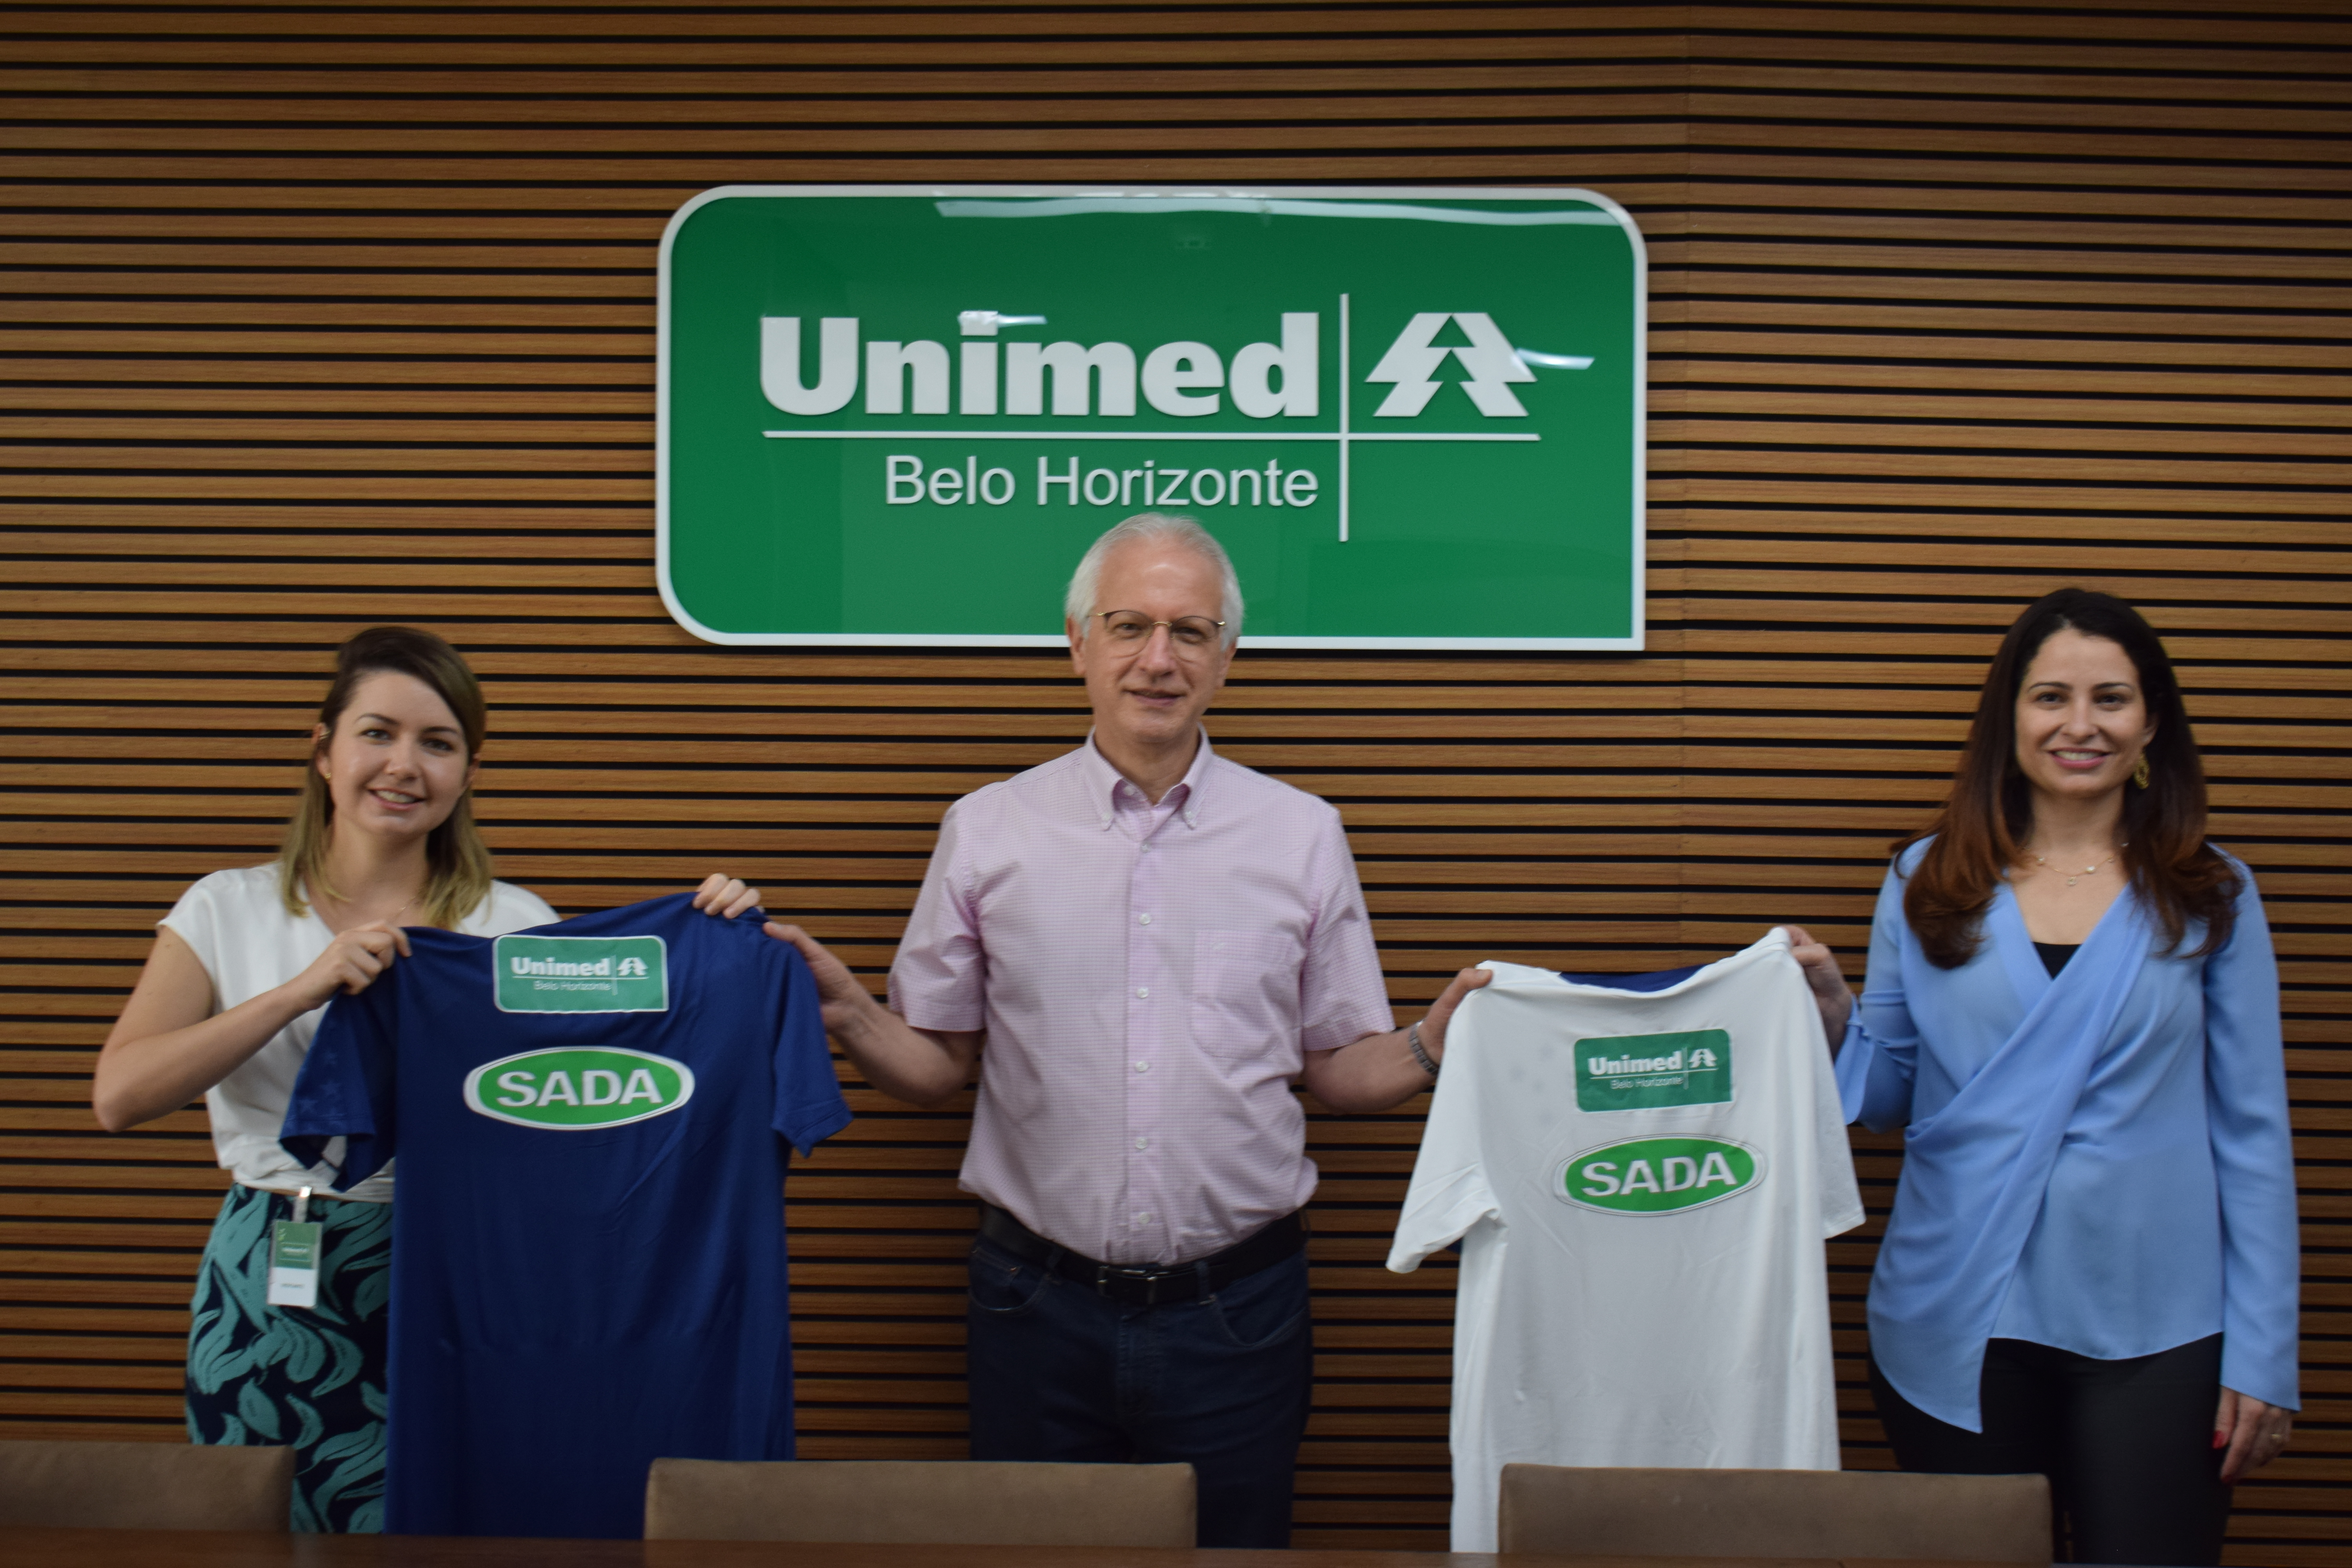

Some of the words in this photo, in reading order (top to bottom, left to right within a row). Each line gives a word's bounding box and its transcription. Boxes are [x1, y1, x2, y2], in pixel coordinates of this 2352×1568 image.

[760, 310, 1319, 418] Unimed
[886, 455, 1014, 505] Belo
[1037, 456, 1318, 506] Horizonte
[511, 956, 611, 976] Unimed
[1588, 1051, 1682, 1075] Unimed
[496, 1069, 663, 1107] SADA
[1581, 1152, 1738, 1197] SADA
